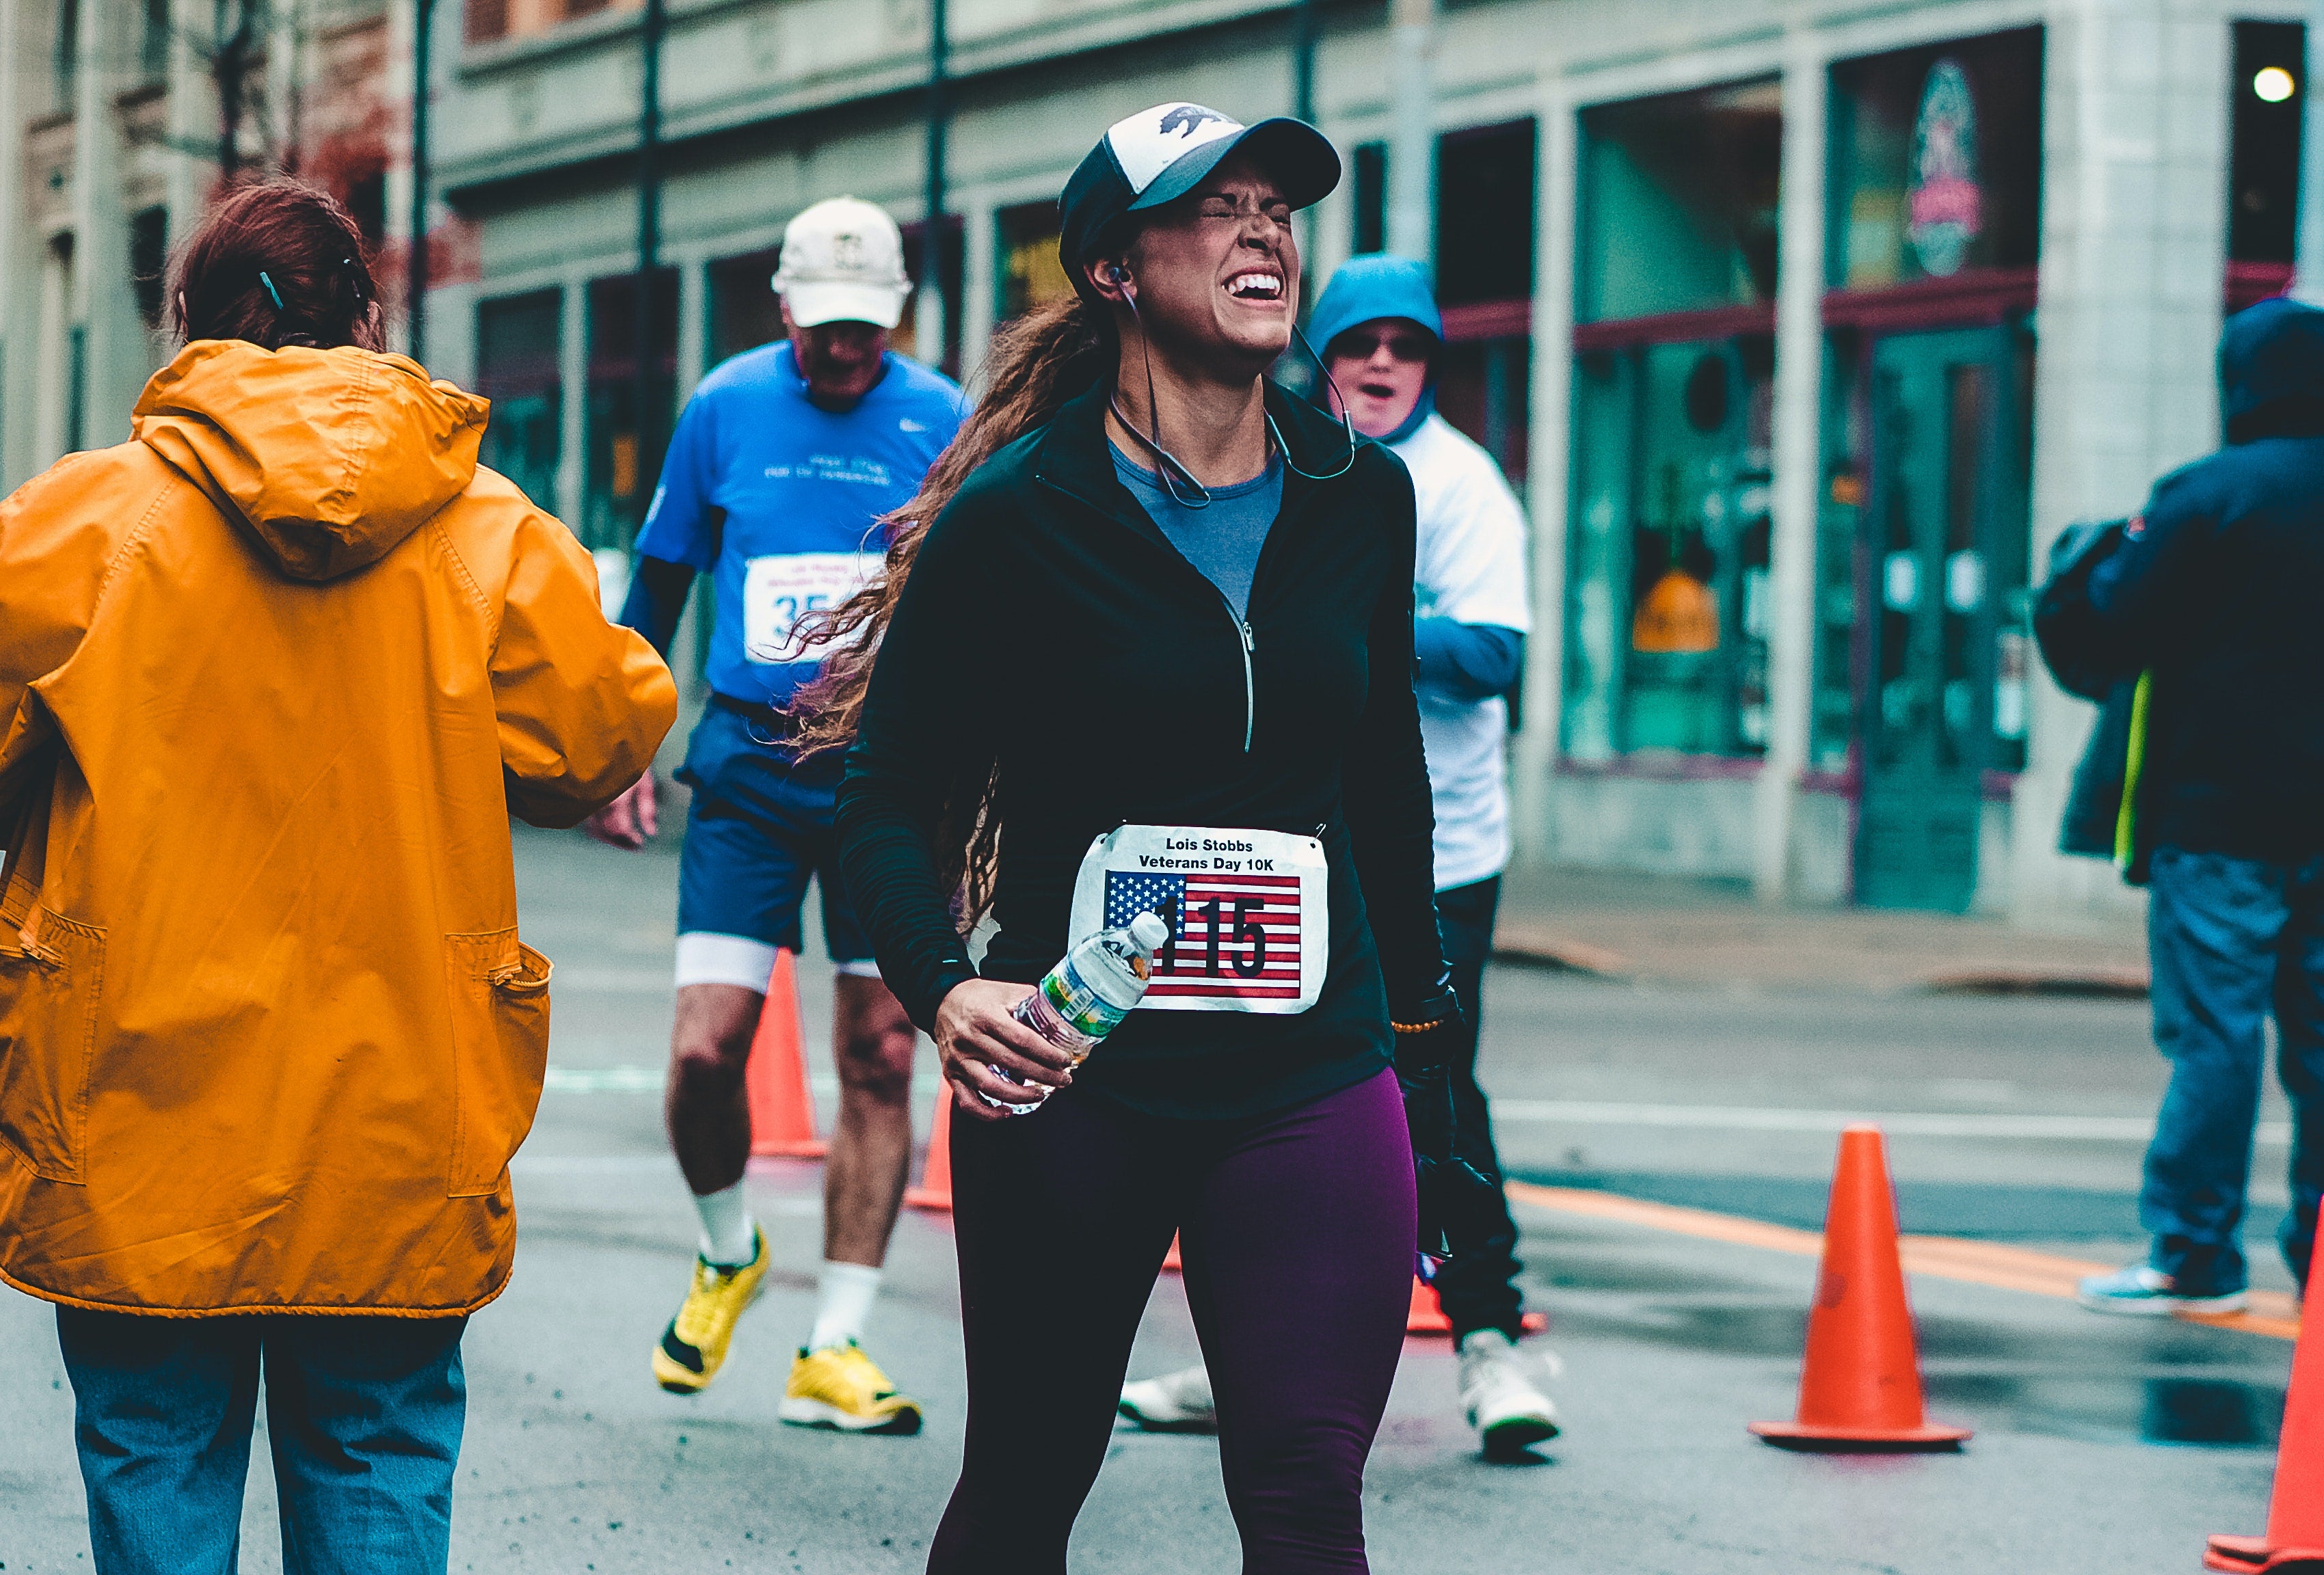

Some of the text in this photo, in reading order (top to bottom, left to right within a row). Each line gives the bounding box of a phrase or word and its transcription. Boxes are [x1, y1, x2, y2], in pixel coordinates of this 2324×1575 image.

[1166, 838, 1253, 852] Lois Stobbs
[1139, 855, 1274, 872] Veterans Day 10K
[1156, 896, 1266, 978] 115
